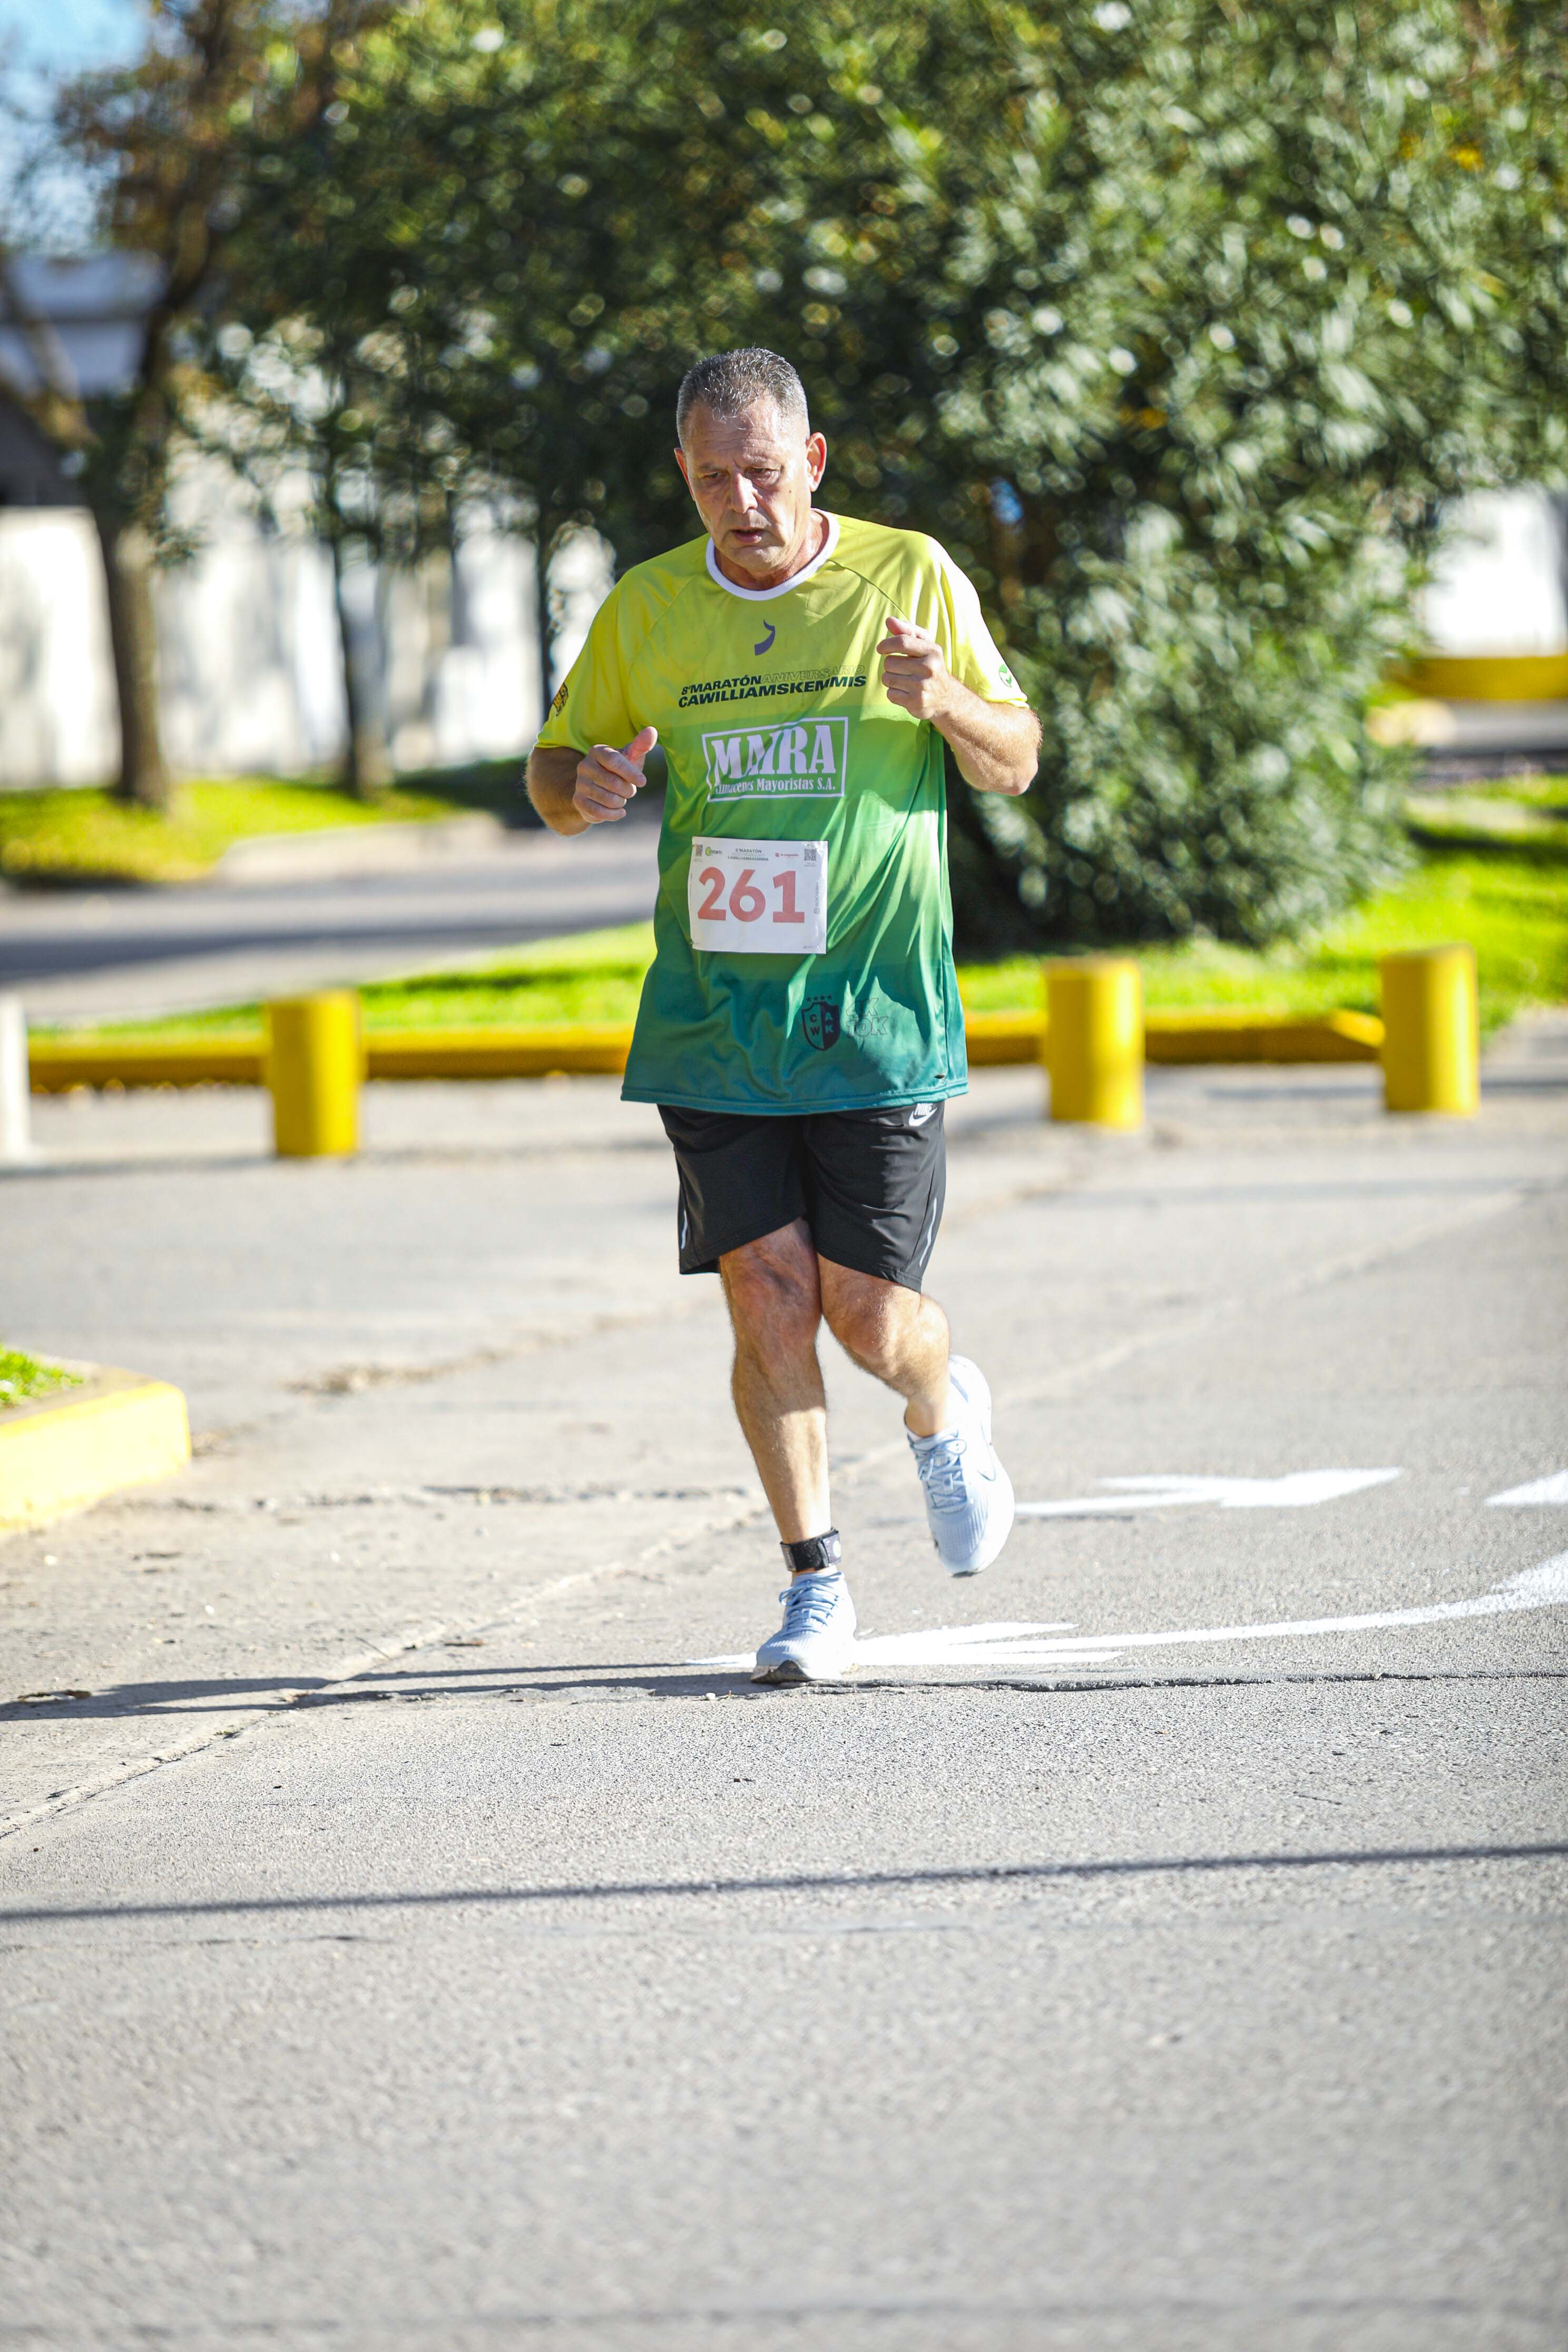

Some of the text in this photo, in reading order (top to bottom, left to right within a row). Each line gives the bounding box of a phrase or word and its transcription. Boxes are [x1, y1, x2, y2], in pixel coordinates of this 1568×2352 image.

[678, 675, 867, 708] CAWILLIAMSKEMMIS
[757, 778, 814, 792] Mayoristas
[817, 777, 836, 790] S.A.
[697, 867, 805, 923] 261
[846, 1016, 889, 1037] 10K
[914, 1103, 934, 1116] NIKE
